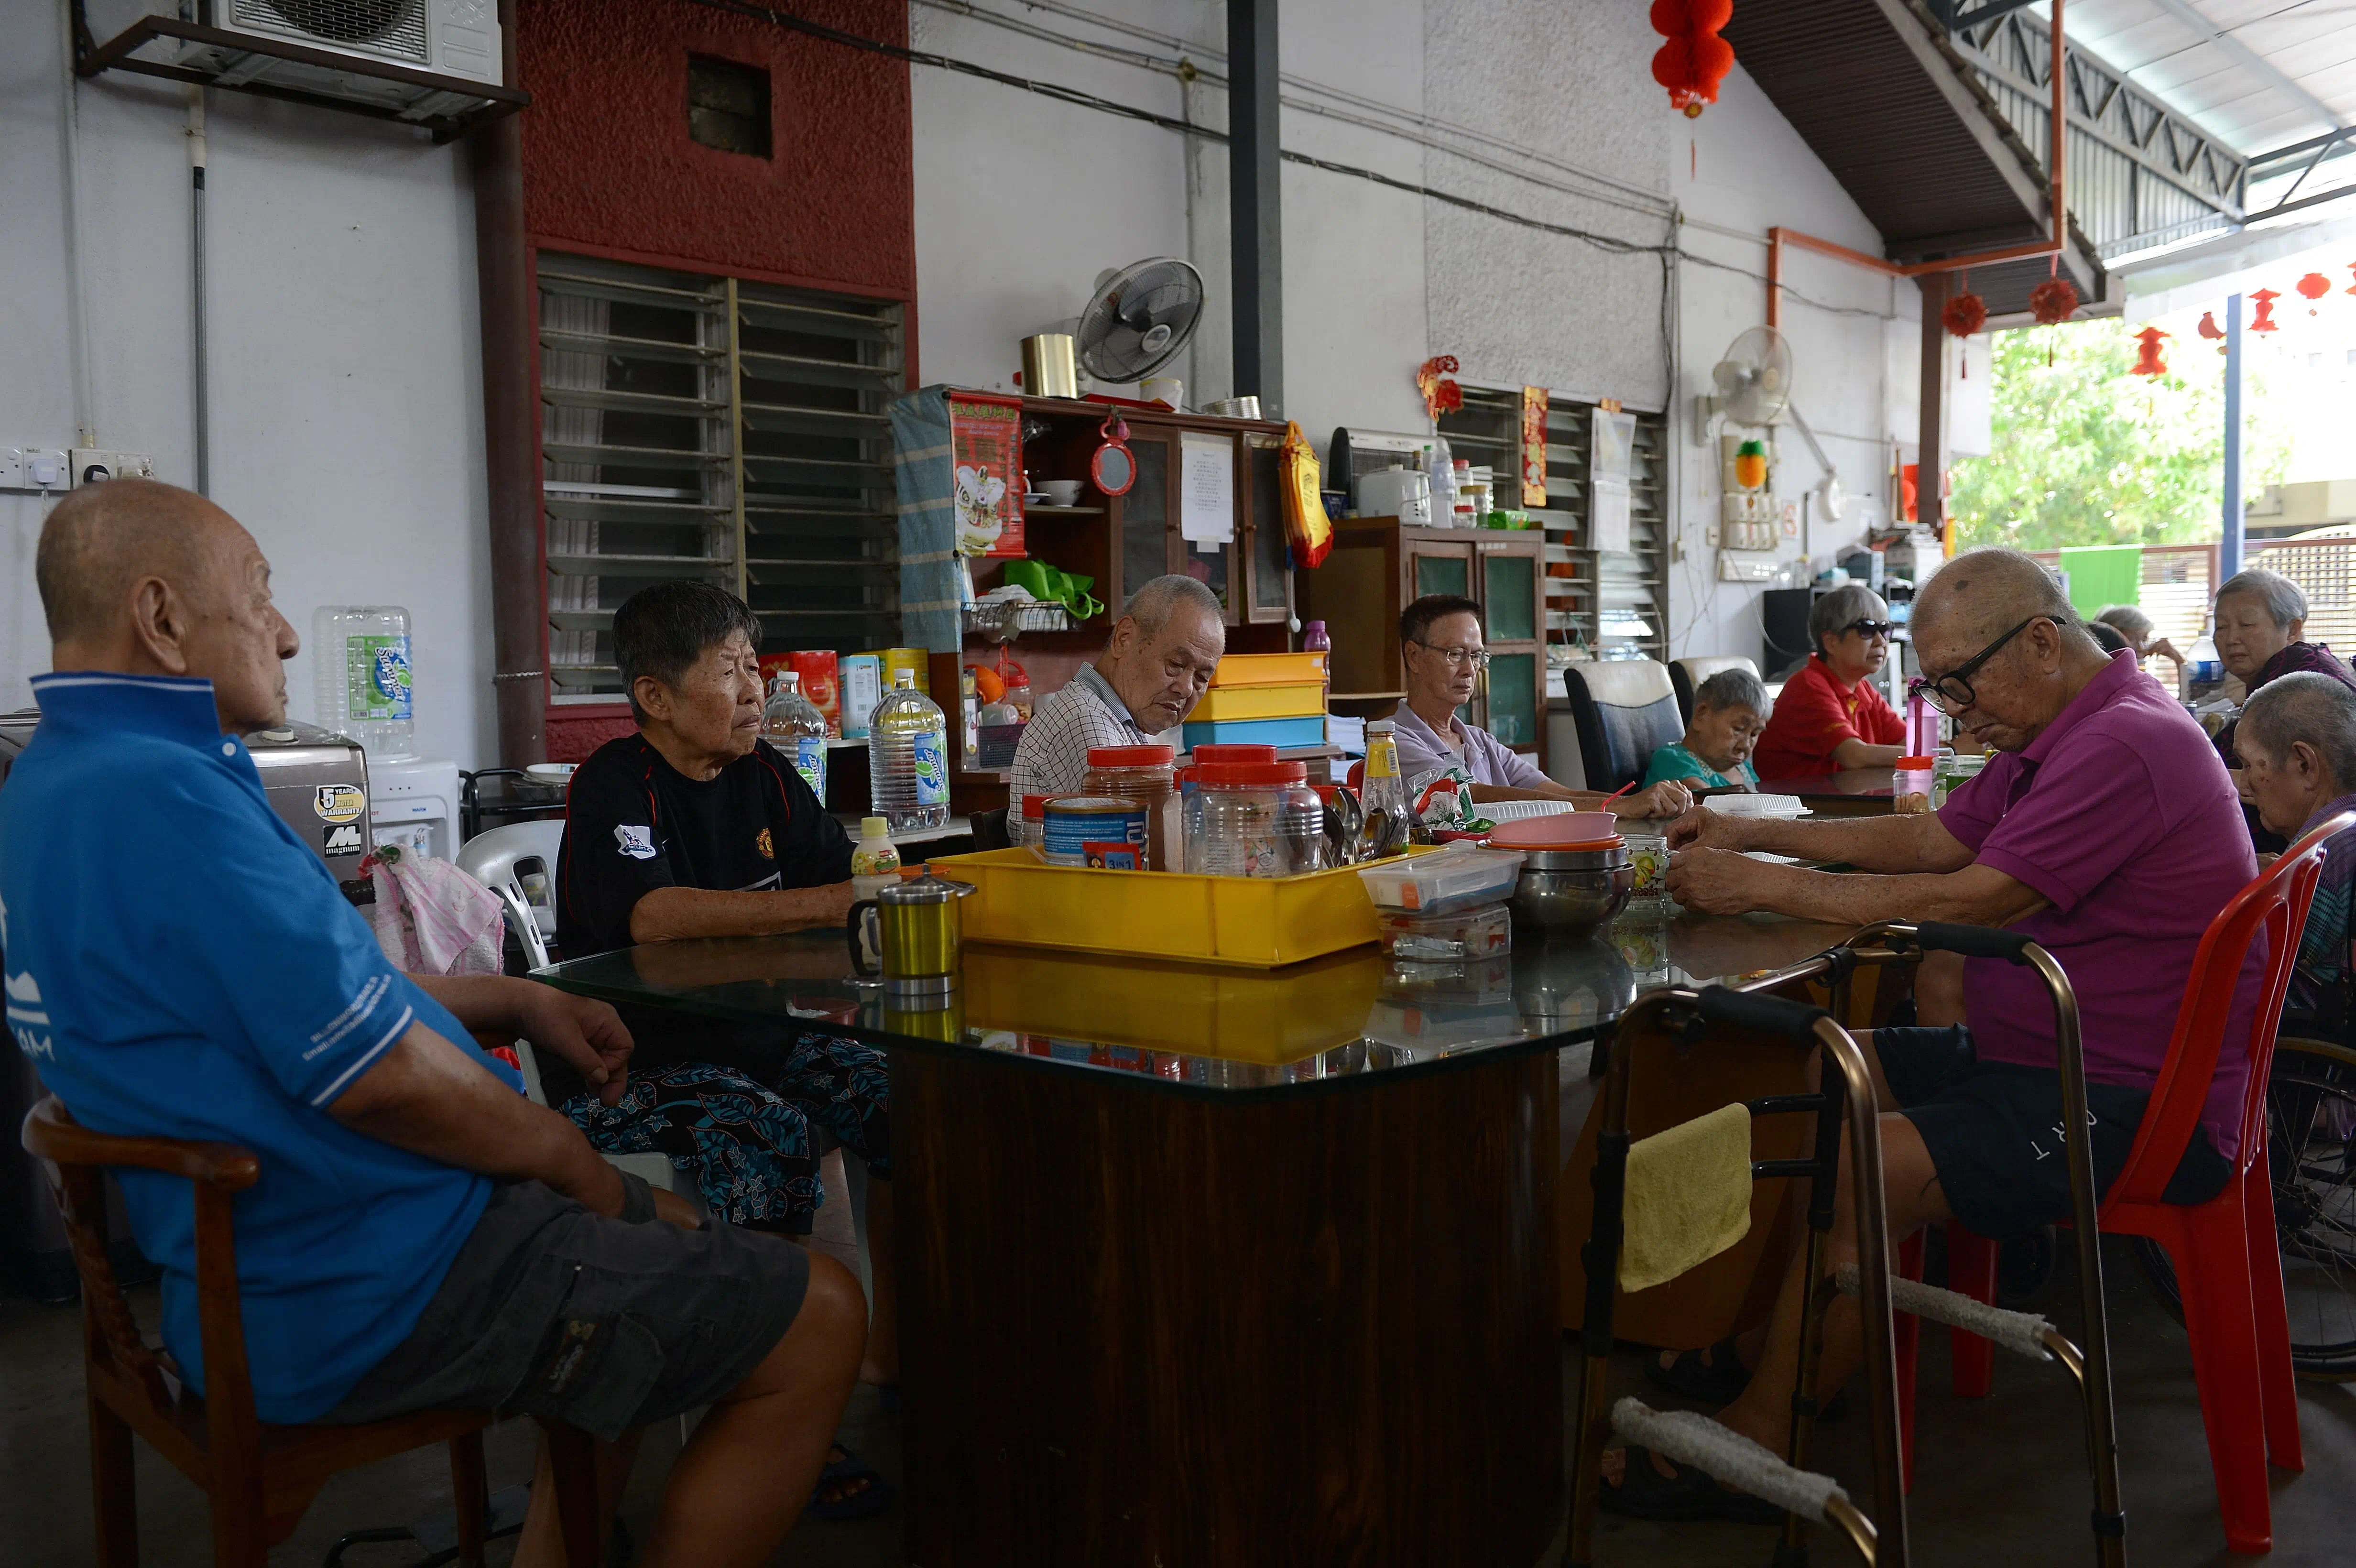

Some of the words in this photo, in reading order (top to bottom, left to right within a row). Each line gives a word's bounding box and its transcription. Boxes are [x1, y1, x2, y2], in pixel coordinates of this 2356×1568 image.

[924, 749, 944, 791] Summer
[322, 788, 334, 808] 5
[320, 807, 360, 817] WARRANTY
[326, 845, 360, 855] magnum
